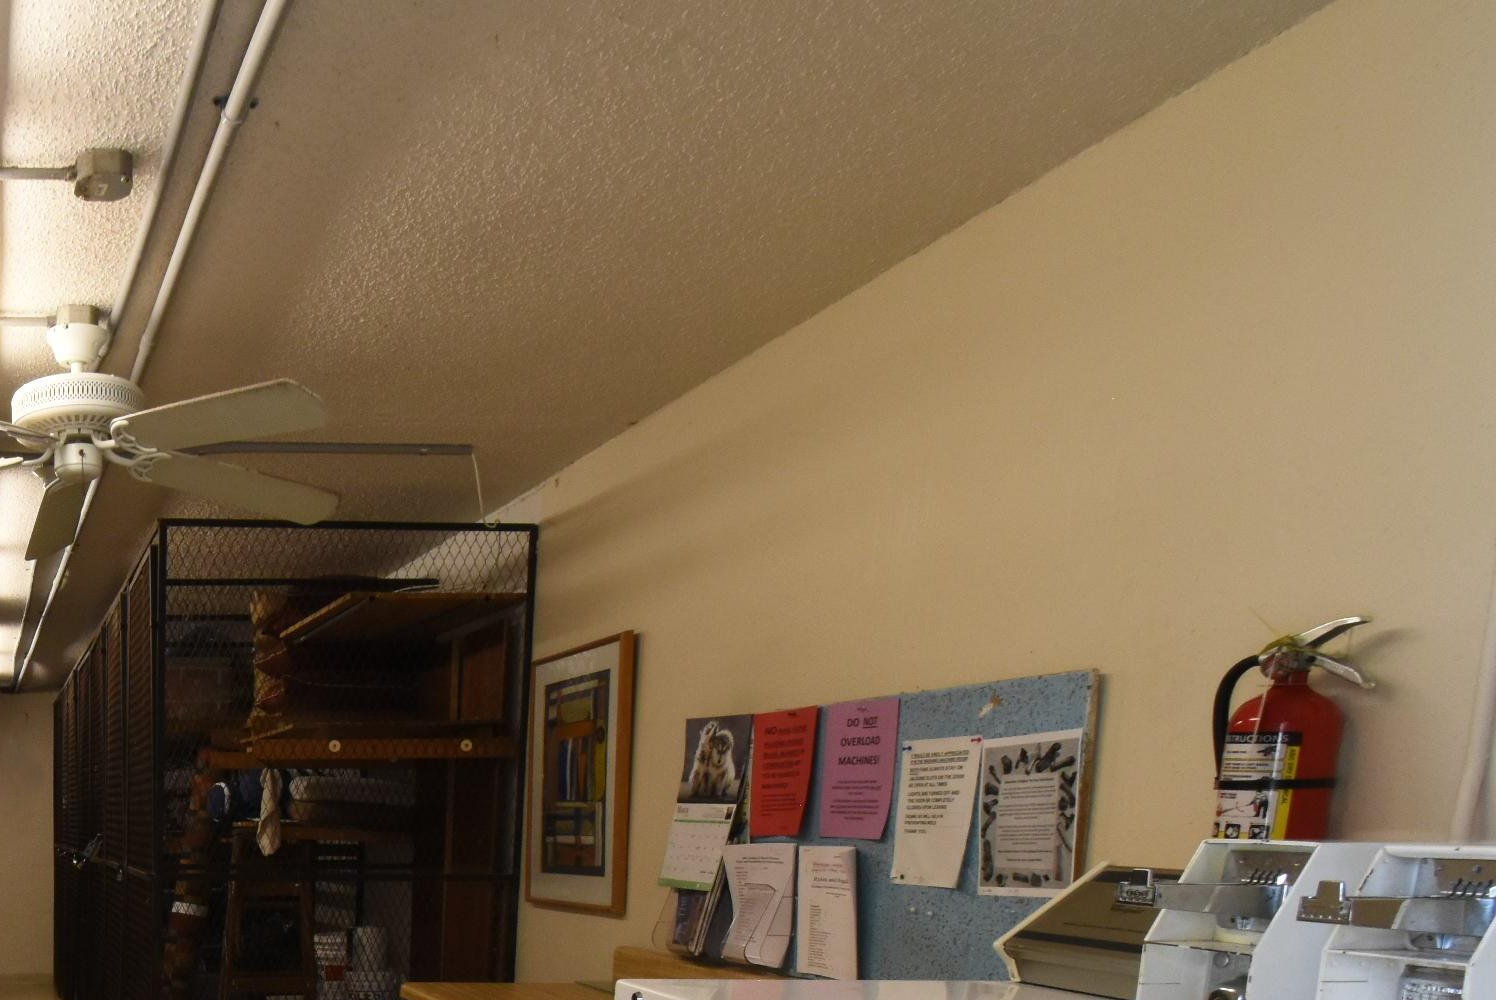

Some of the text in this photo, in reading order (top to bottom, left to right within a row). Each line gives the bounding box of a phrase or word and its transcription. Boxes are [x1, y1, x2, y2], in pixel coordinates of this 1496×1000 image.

[847, 716, 878, 727] DO NOT
[840, 736, 880, 746] OVERLOAD
[838, 755, 880, 766] MACHINES!
